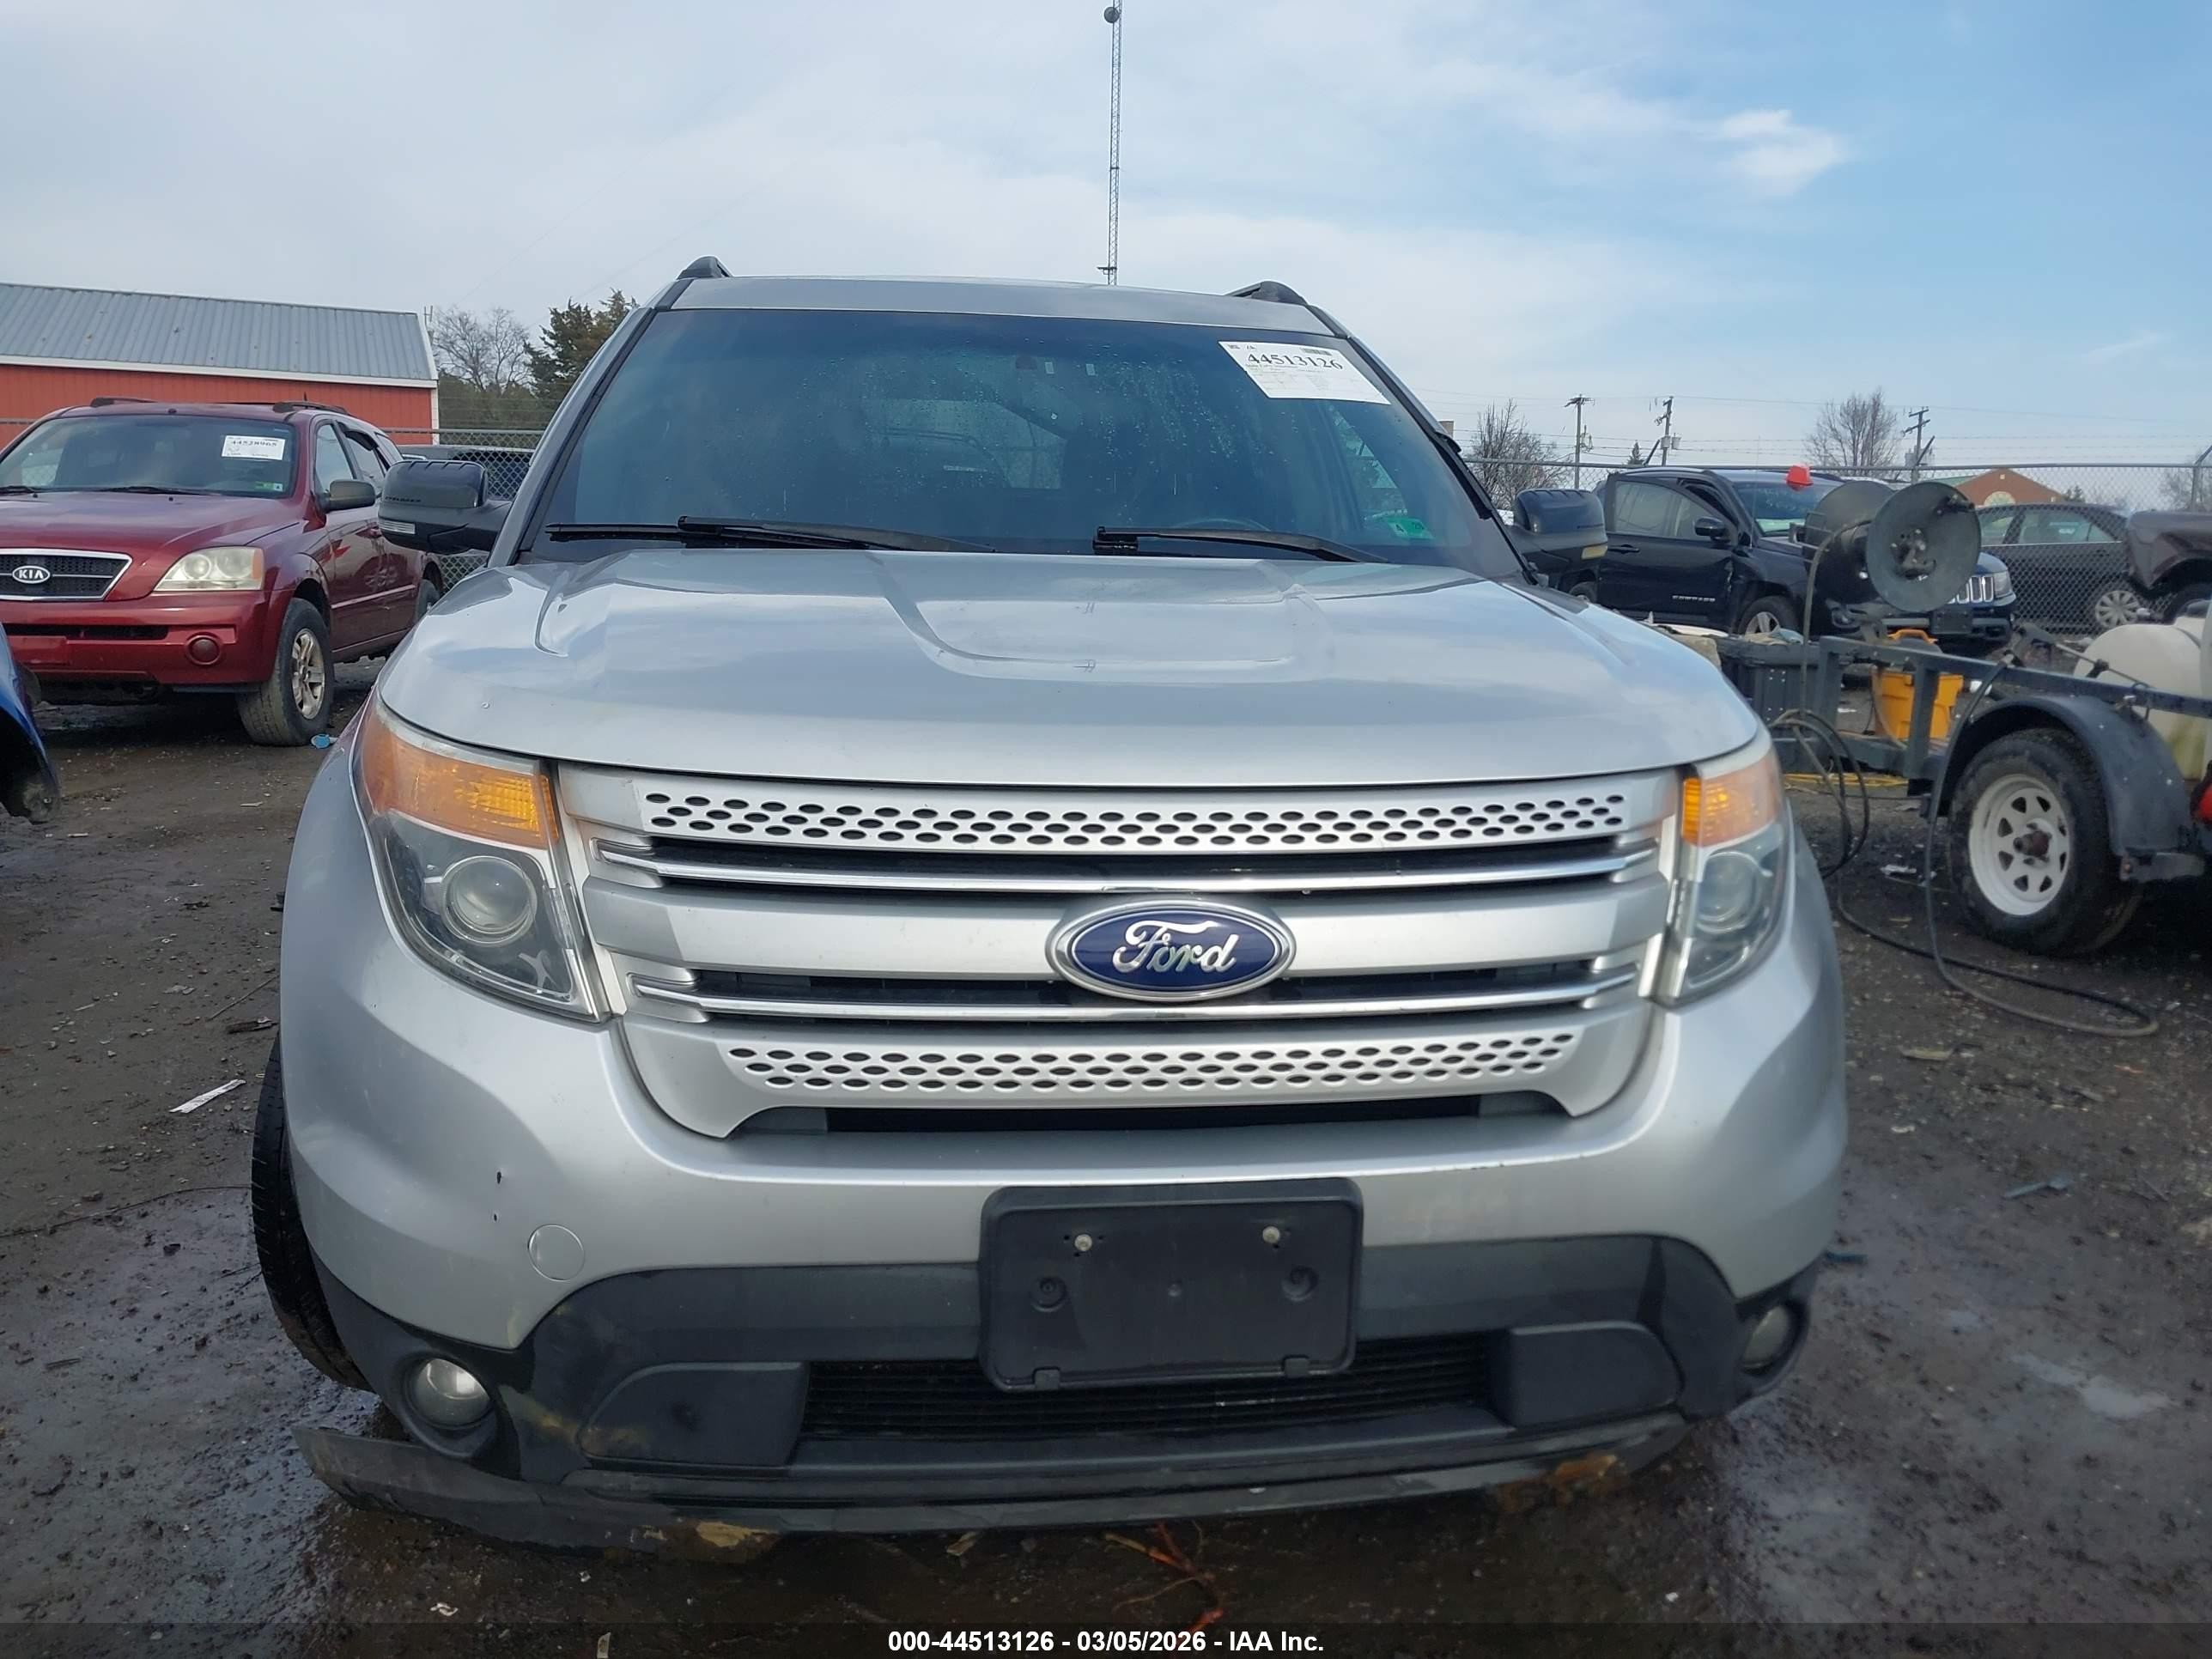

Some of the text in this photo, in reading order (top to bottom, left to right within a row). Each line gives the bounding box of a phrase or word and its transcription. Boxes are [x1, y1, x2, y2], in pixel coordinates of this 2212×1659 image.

[1248, 353, 1344, 370] 44513126
[18, 568, 44, 580] KIA
[1112, 920, 1240, 973] Ford
